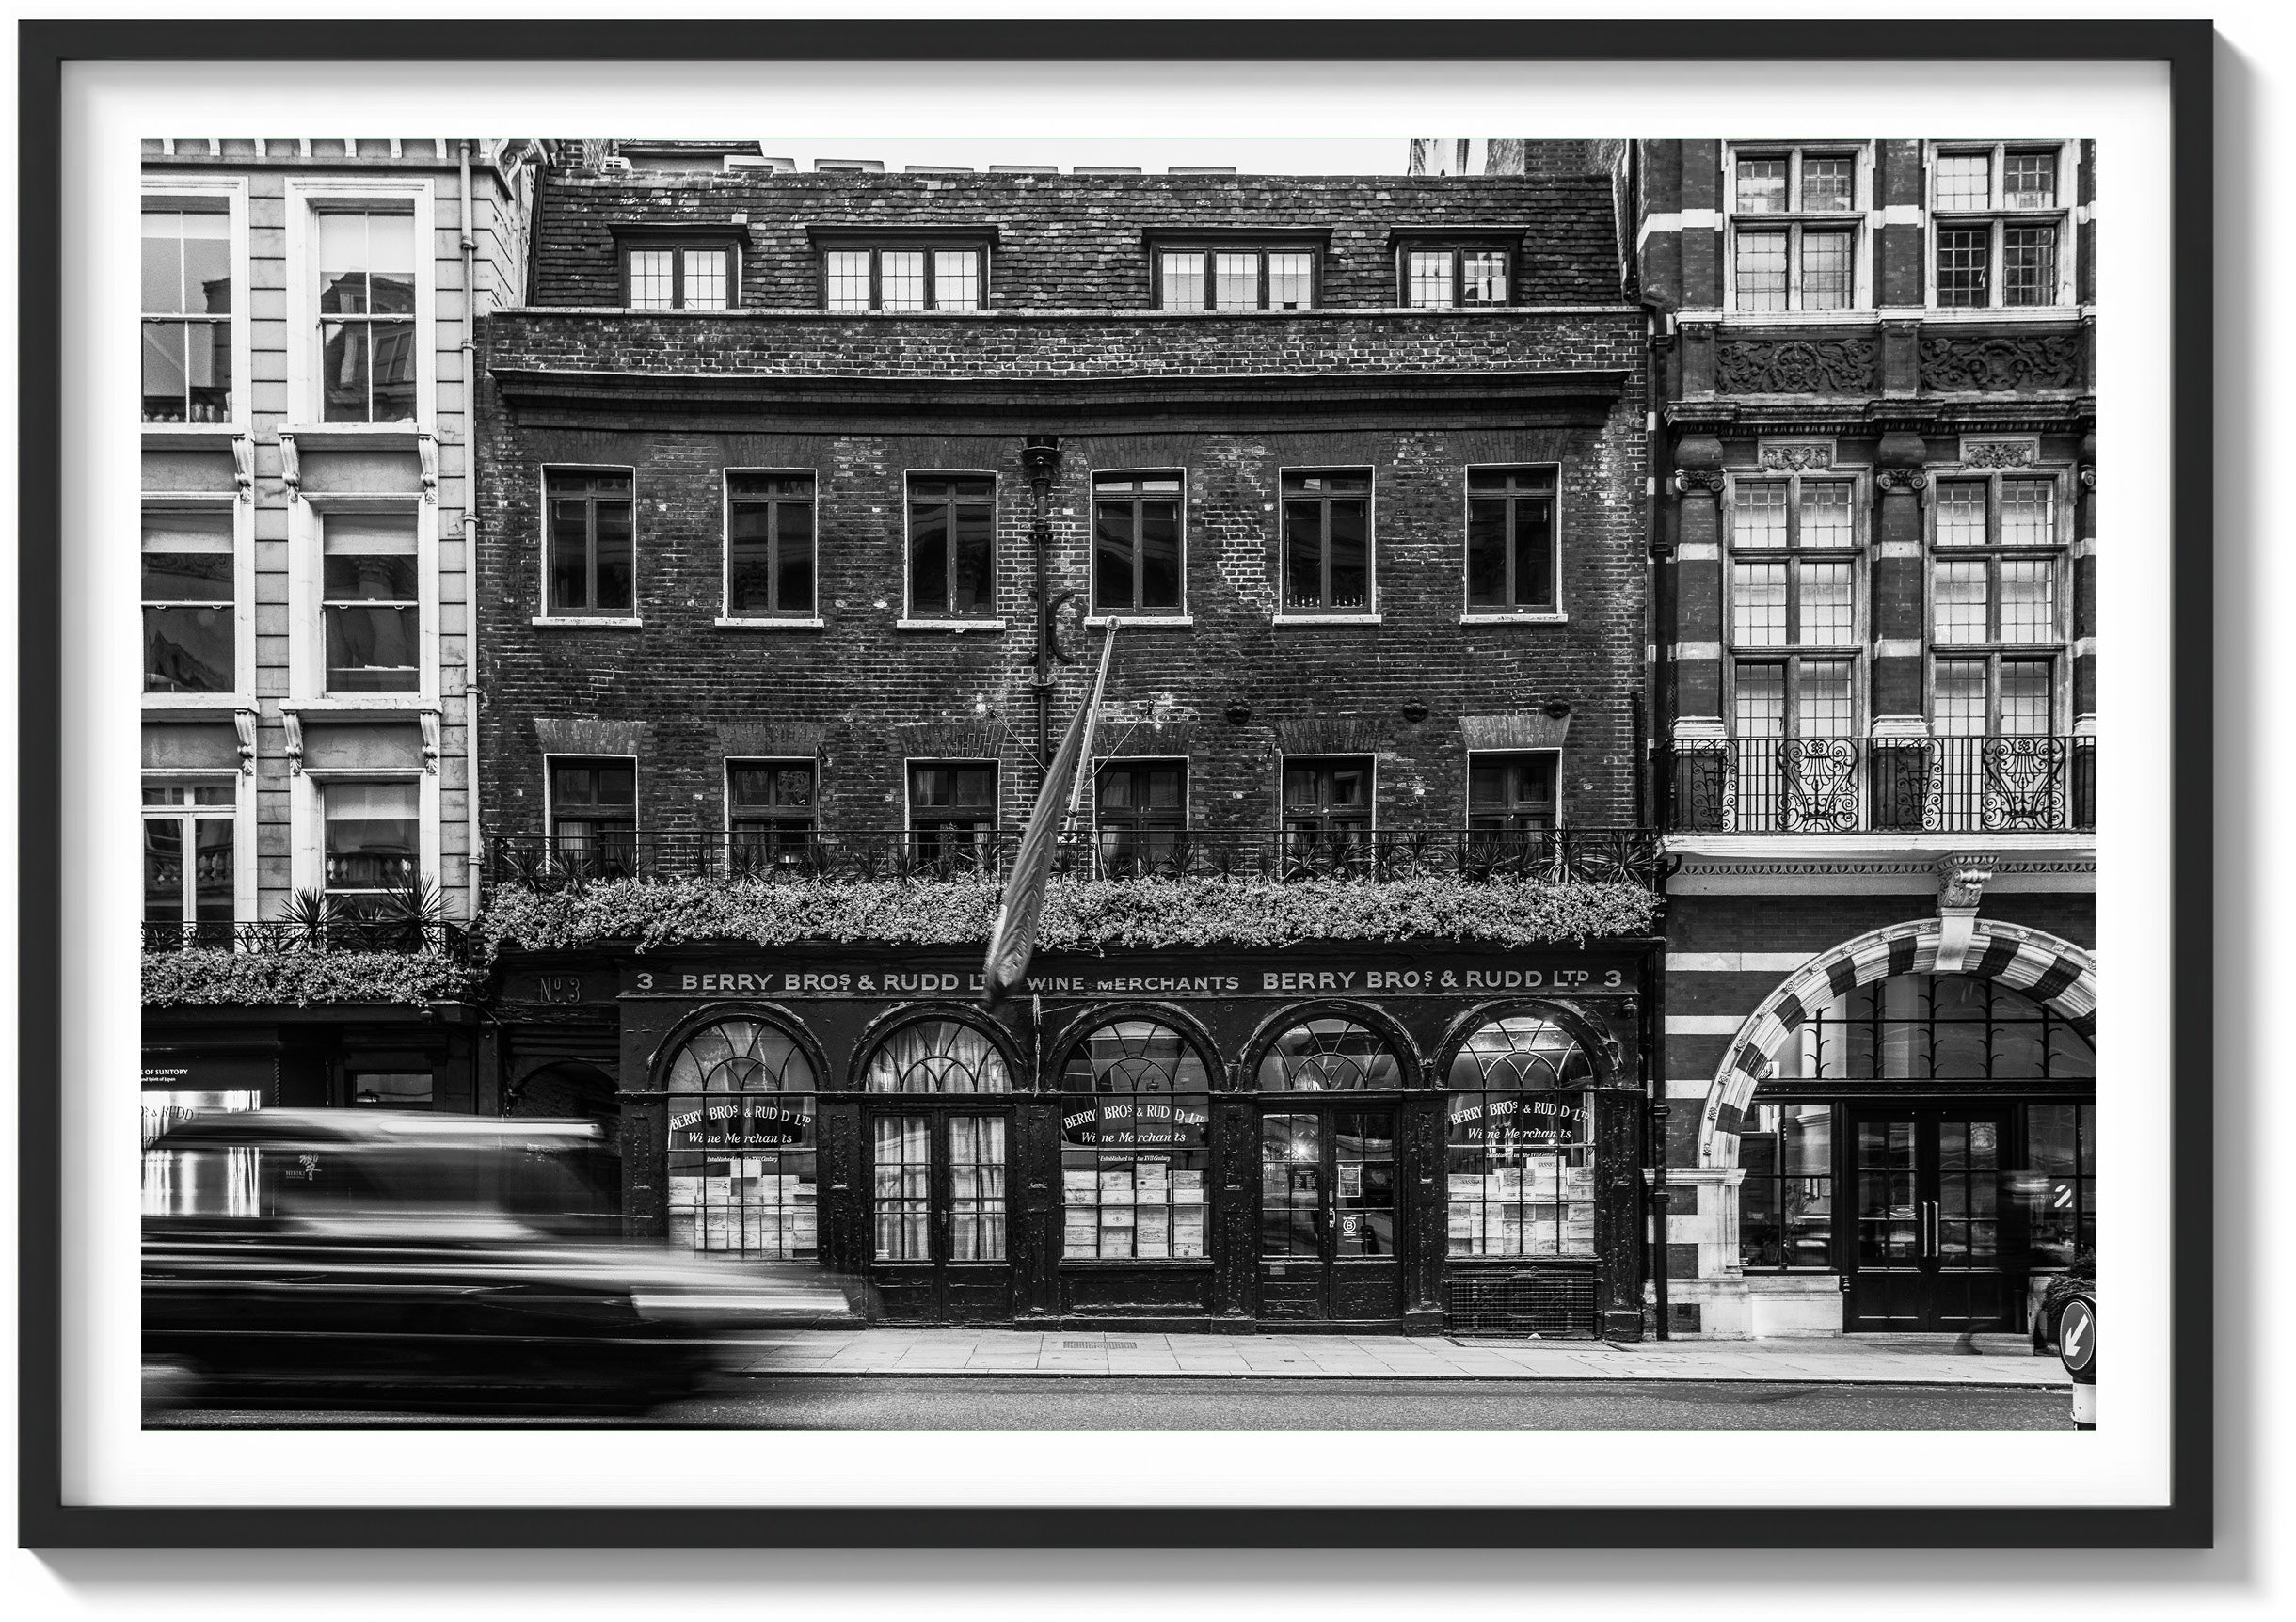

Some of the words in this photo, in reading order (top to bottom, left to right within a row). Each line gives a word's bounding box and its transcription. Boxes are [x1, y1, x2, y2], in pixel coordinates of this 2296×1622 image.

[568, 978, 580, 1004] 3
[637, 973, 654, 990] 3
[682, 974, 773, 990] BERRY
[857, 974, 877, 990] &
[884, 974, 959, 990] RUDD
[969, 973, 988, 991] LT
[1027, 978, 1084, 990] WINE
[1097, 977, 1239, 991] MERCHANTS
[1263, 971, 1355, 990] BERRY
[1440, 970, 1459, 988] &
[1466, 970, 1543, 988] RUDD
[1603, 970, 1622, 988] 3
[670, 1109, 703, 1131] BERRY
[744, 1107, 752, 1118] &
[754, 1105, 790, 1121] RUDD
[1063, 1109, 1097, 1129] BERRY
[1136, 1107, 1143, 1117] &
[1147, 1105, 1185, 1121] RUDD
[1450, 1105, 1483, 1126] BERRY
[1523, 1104, 1531, 1114] &
[1534, 1102, 1570, 1118] RUDD
[689, 1132, 721, 1143] Wine
[724, 1132, 792, 1144] Merchants
[1082, 1132, 1114, 1143] Wine
[1118, 1132, 1186, 1142] Merchants
[1468, 1128, 1500, 1139] Wine
[1504, 1128, 1571, 1138] Merchants
